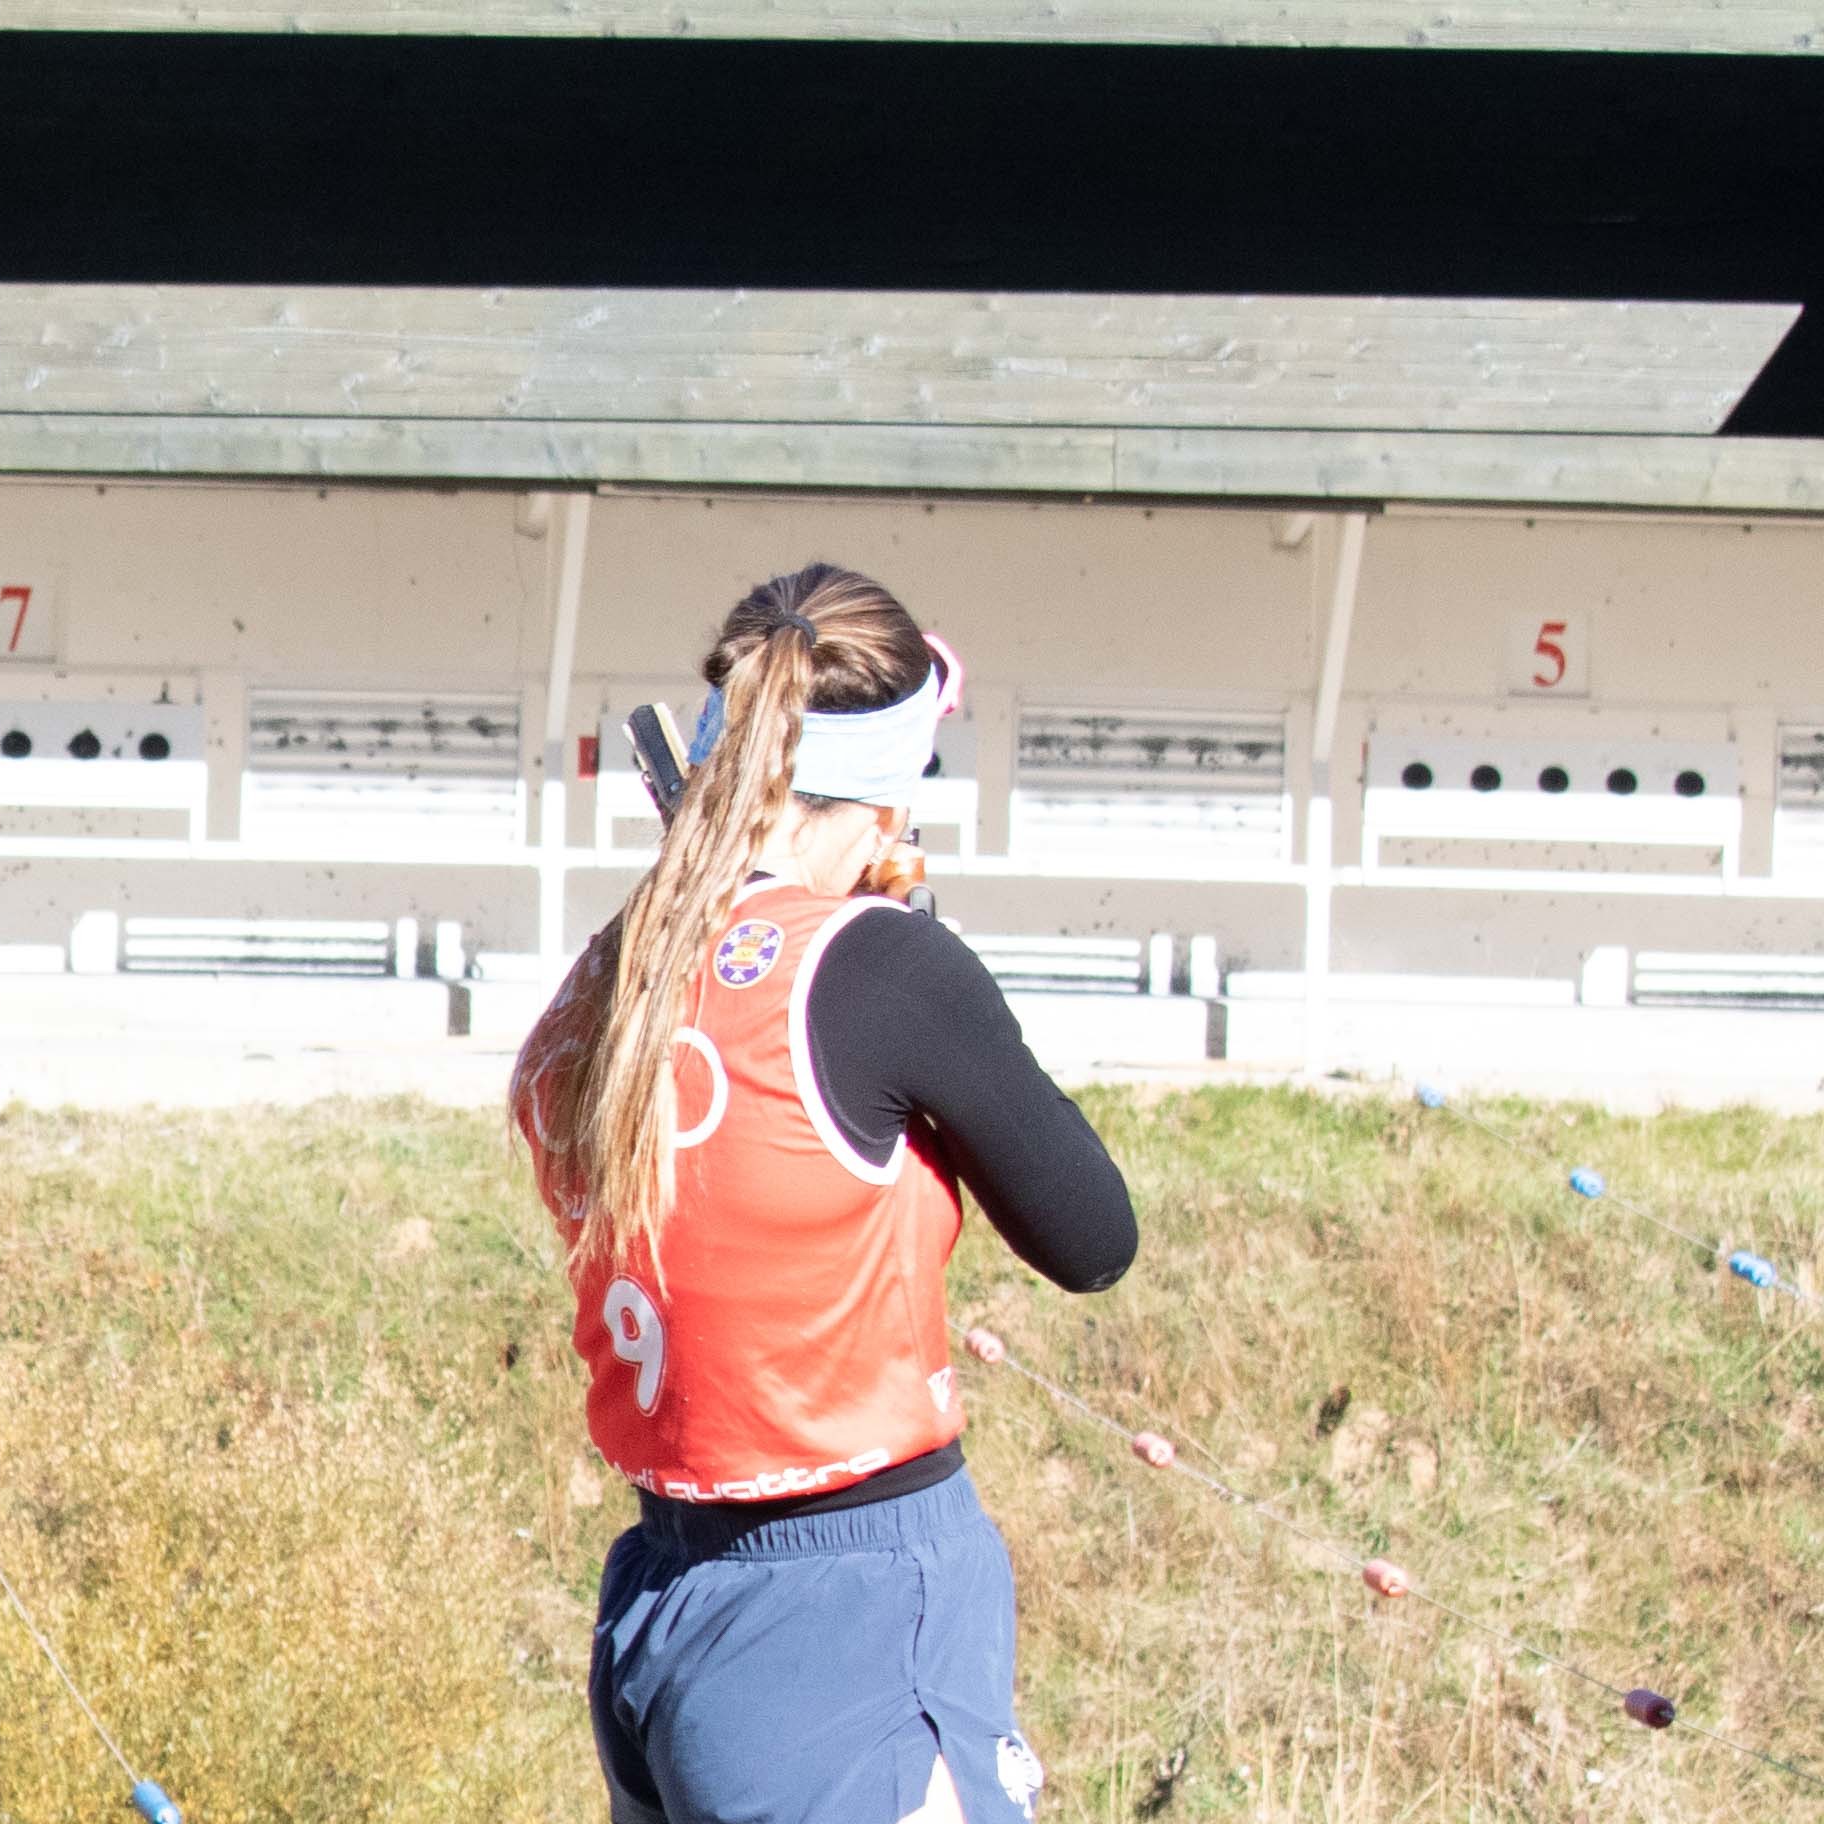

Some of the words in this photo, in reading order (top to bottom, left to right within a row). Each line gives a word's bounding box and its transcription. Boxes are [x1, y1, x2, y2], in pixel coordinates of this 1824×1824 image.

[1532, 621, 1567, 688] 5
[602, 1273, 668, 1417] 9
[664, 1448, 891, 1504] quattro
